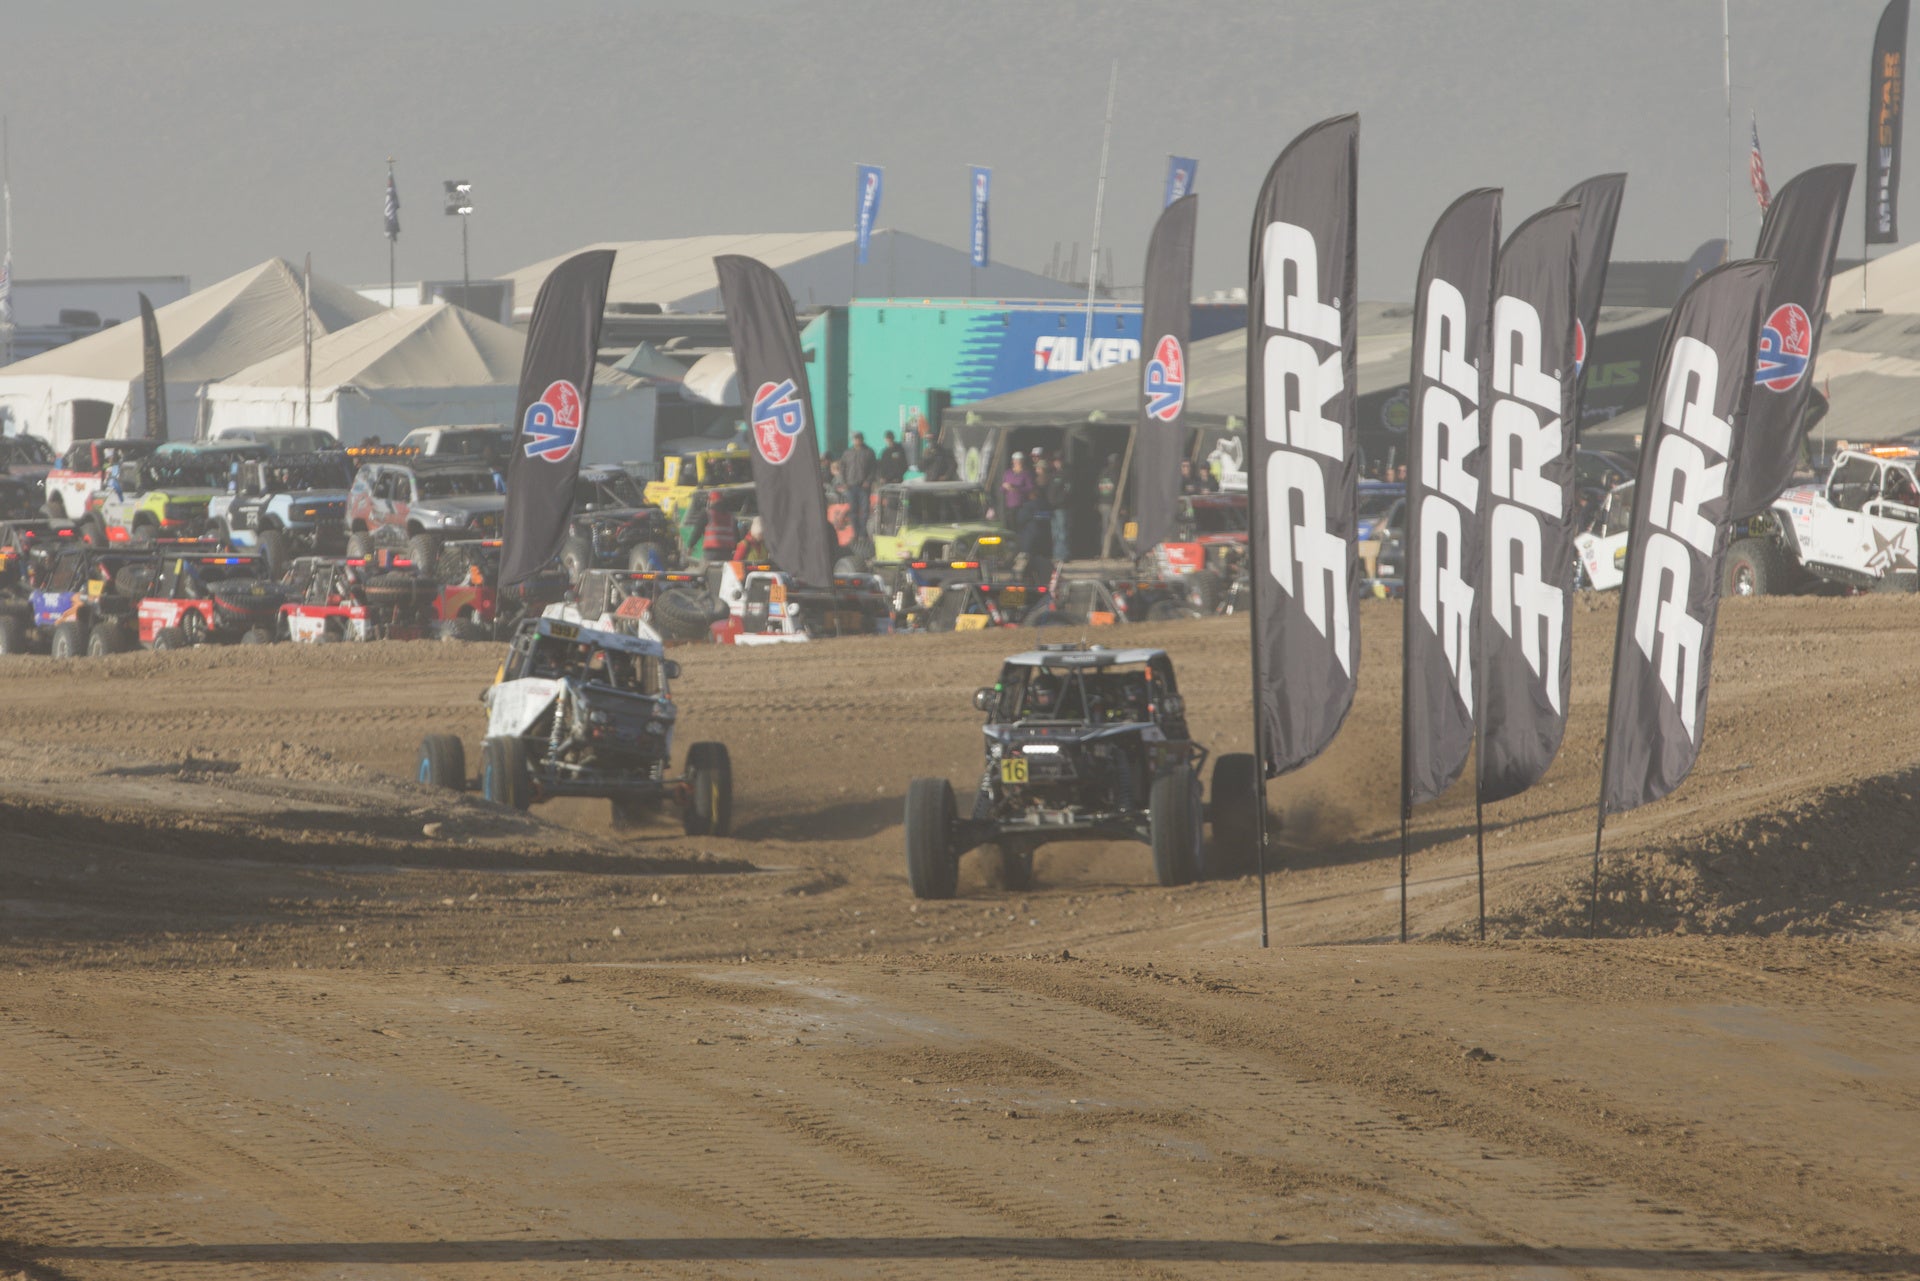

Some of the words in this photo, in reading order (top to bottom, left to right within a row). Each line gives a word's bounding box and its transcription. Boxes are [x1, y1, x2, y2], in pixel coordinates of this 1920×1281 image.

[1878, 52, 1895, 233] MILESTAR
[1755, 325, 1809, 385] VP
[1784, 304, 1804, 353] Racing
[557, 382, 577, 425] Racing
[752, 378, 806, 436] VP
[1144, 359, 1183, 419] VP
[522, 401, 579, 458] VP
[1264, 221, 1351, 679] PRP
[1420, 278, 1479, 720] PRP
[1491, 295, 1564, 717] PRP
[1635, 336, 1732, 745] PRP
[1002, 759, 1027, 781] 16
